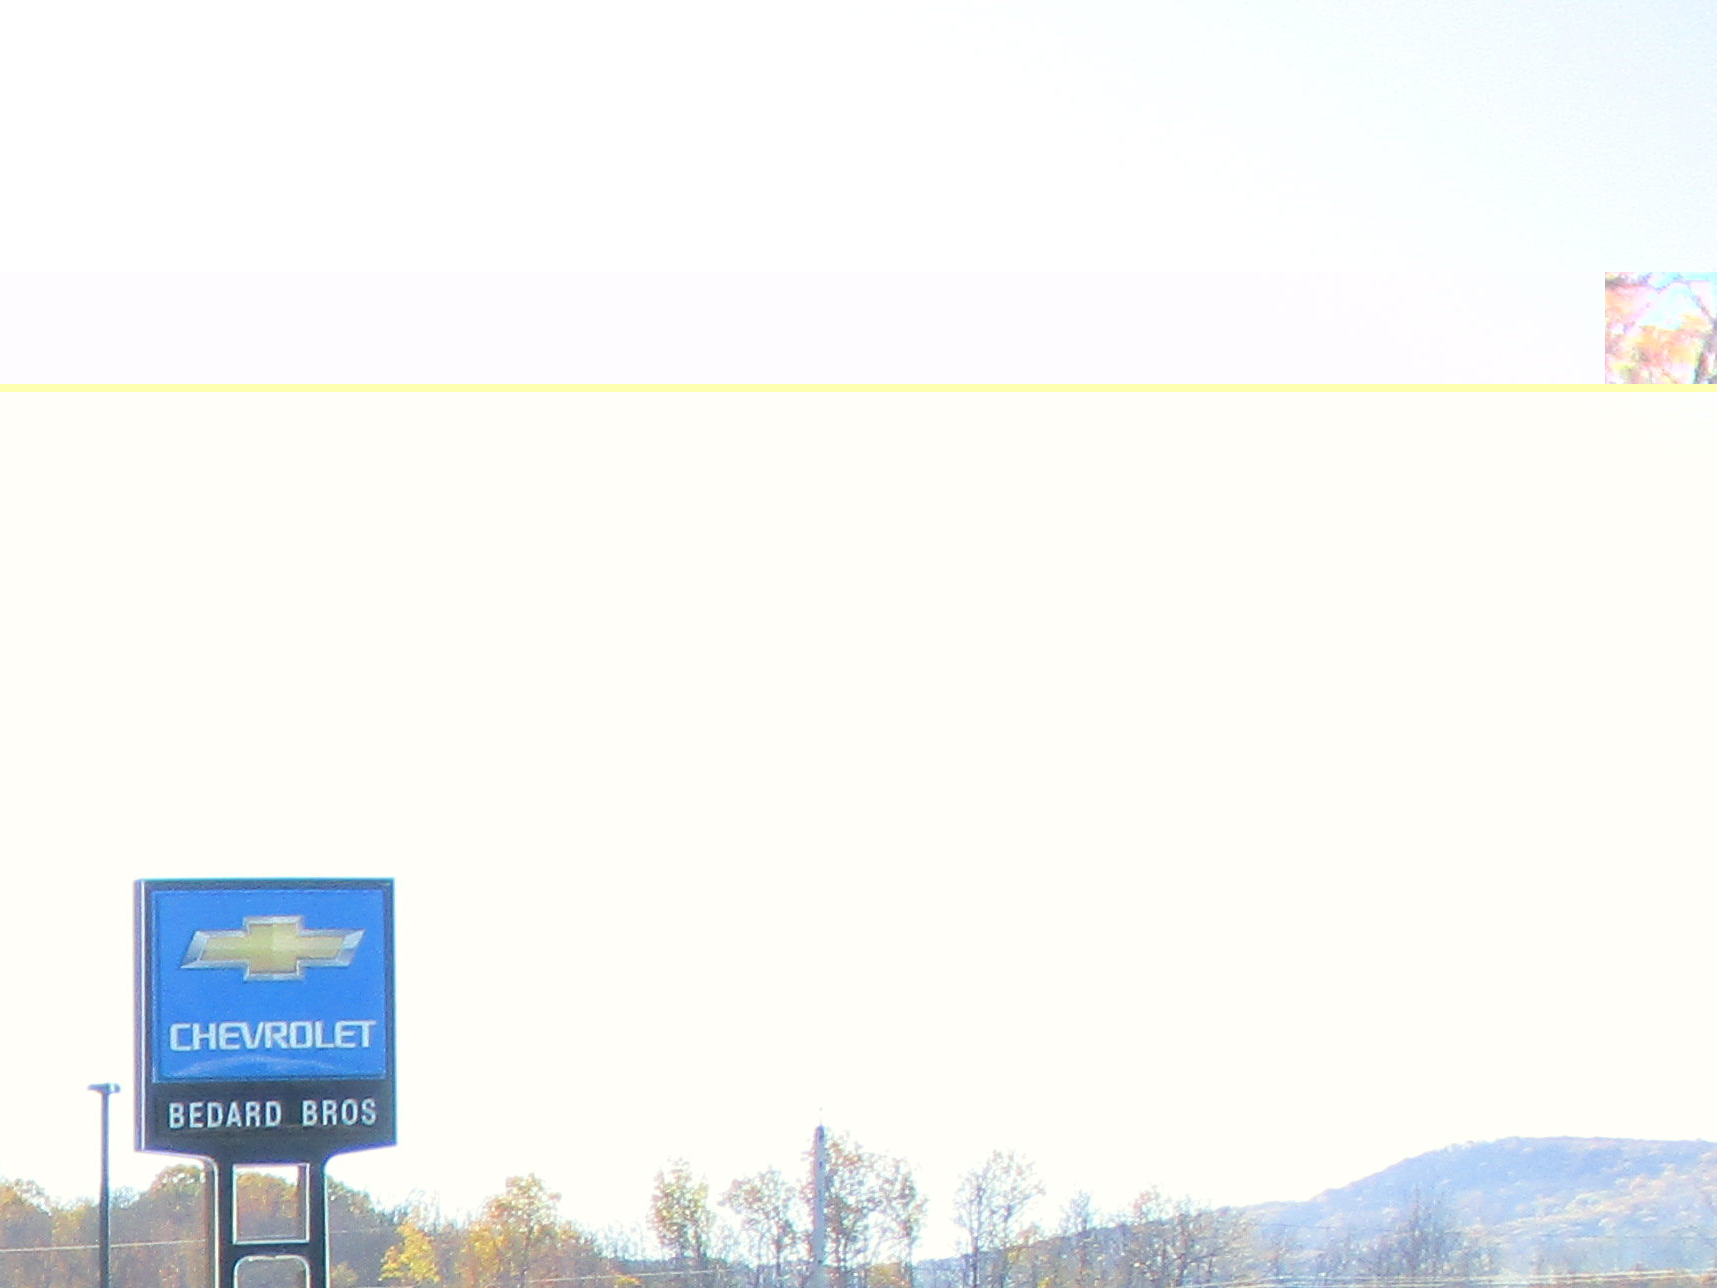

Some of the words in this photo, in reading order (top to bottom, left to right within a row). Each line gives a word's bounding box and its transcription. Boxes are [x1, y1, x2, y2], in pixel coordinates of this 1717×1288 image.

[169, 1020, 377, 1051] CHEVROLET
[168, 1101, 282, 1129] BEDARD
[301, 1098, 377, 1126] BROS
